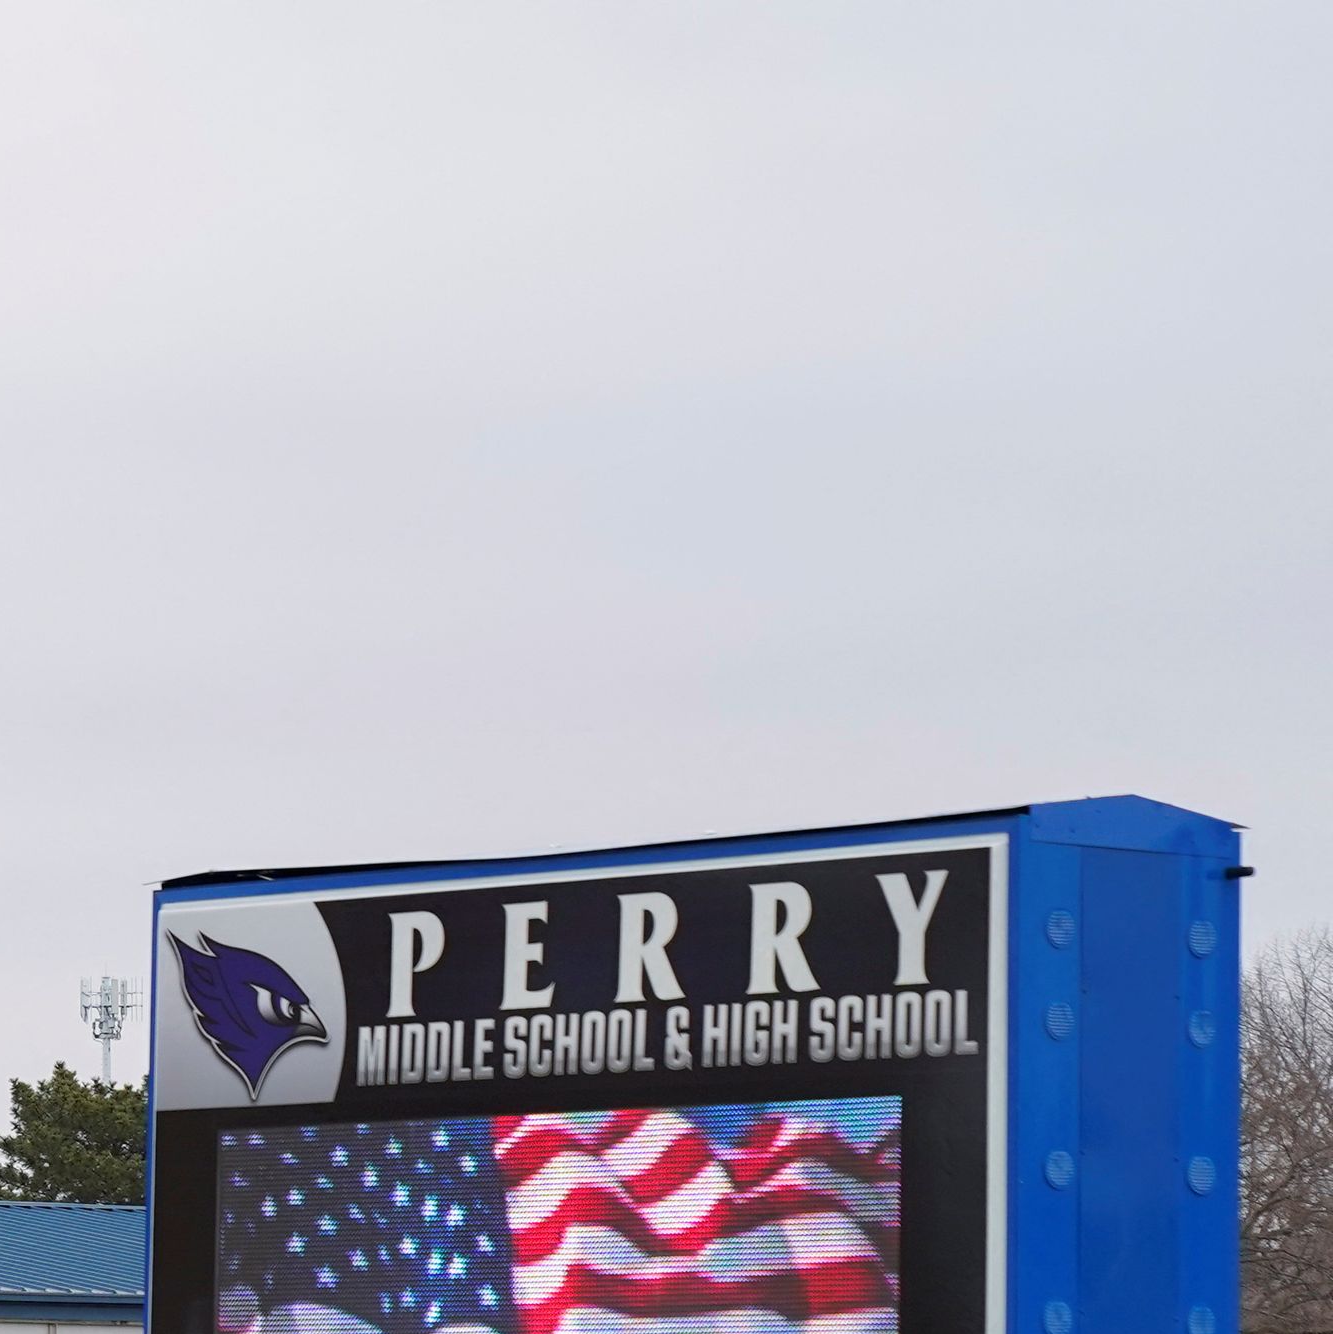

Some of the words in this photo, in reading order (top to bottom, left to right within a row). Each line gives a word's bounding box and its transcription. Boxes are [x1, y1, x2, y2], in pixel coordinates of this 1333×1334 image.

[385, 869, 950, 1018] PERRY
[356, 1018, 495, 1087] MIDDLE
[503, 1007, 655, 1079] SCHOOL
[664, 1005, 693, 1071] &
[701, 998, 798, 1068] HIGH
[808, 988, 979, 1062] SCHOOL
